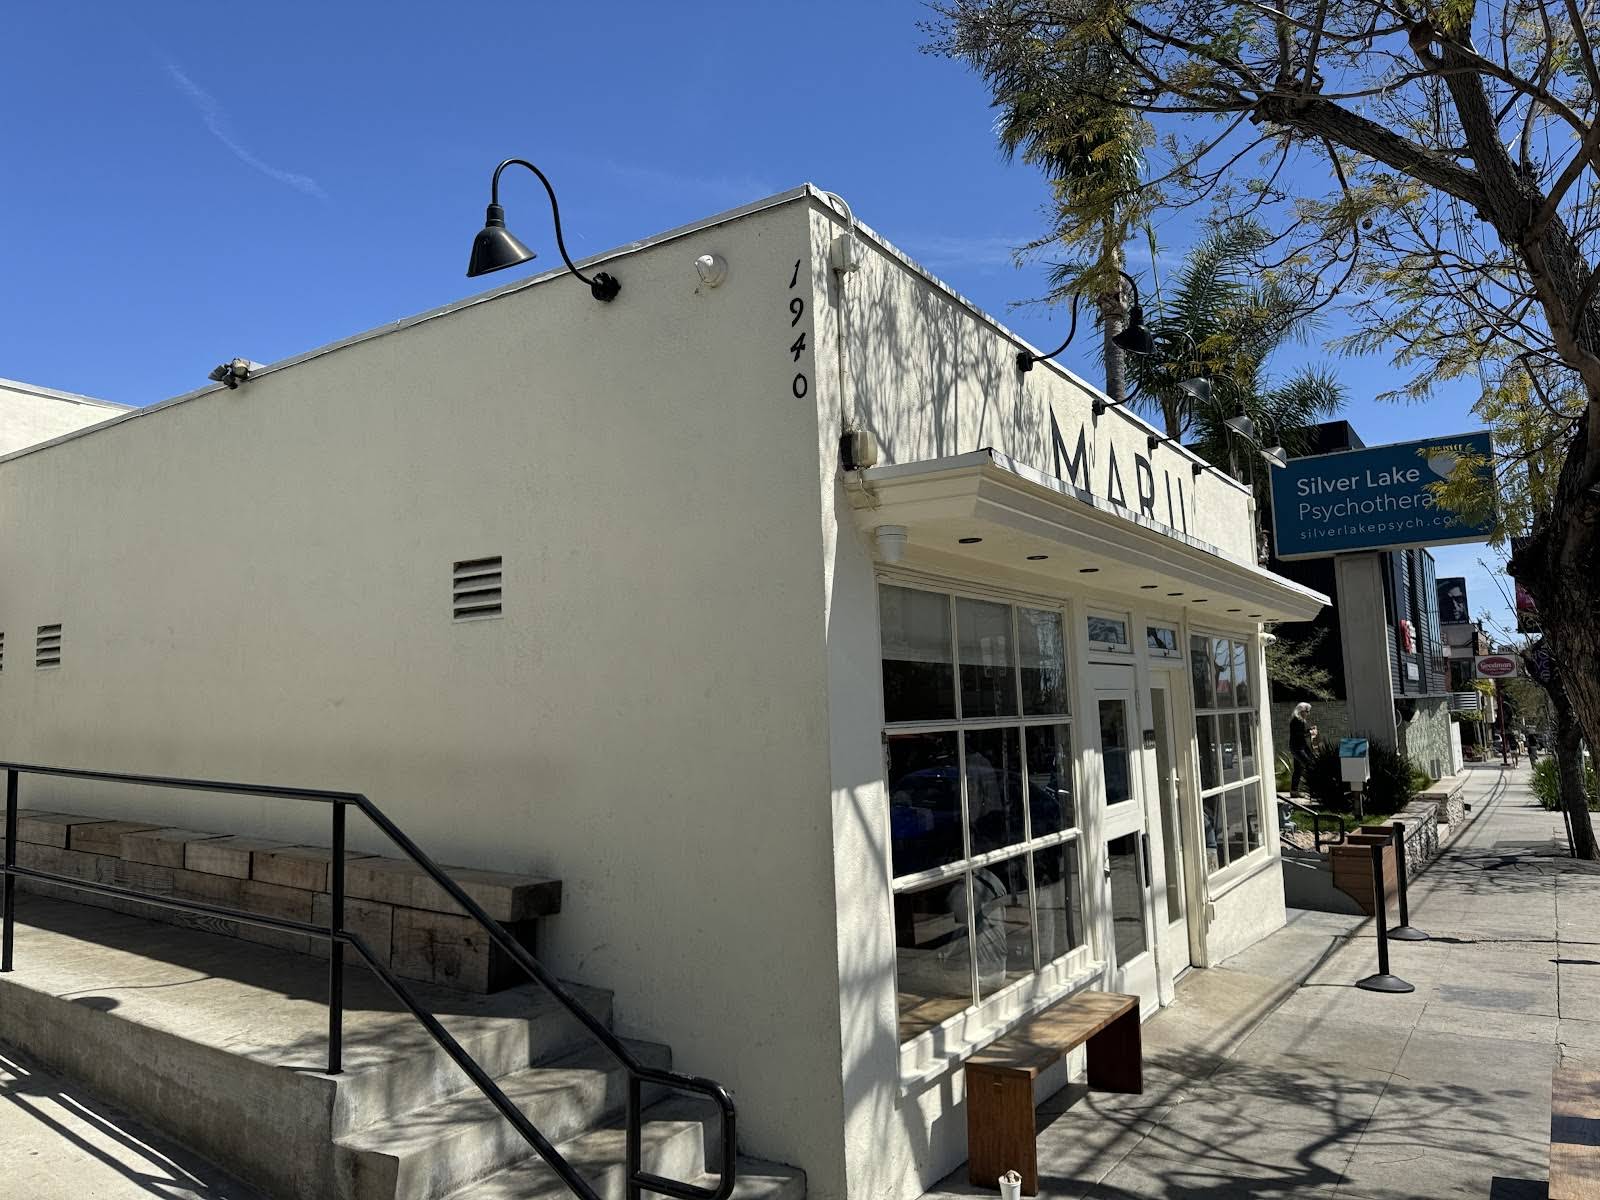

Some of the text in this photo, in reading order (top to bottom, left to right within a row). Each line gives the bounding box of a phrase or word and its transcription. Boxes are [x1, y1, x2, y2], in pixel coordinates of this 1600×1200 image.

[788, 259, 808, 399] 1940
[1297, 466, 1420, 497] Silver Lake
[1299, 492, 1440, 523] Psychothera
